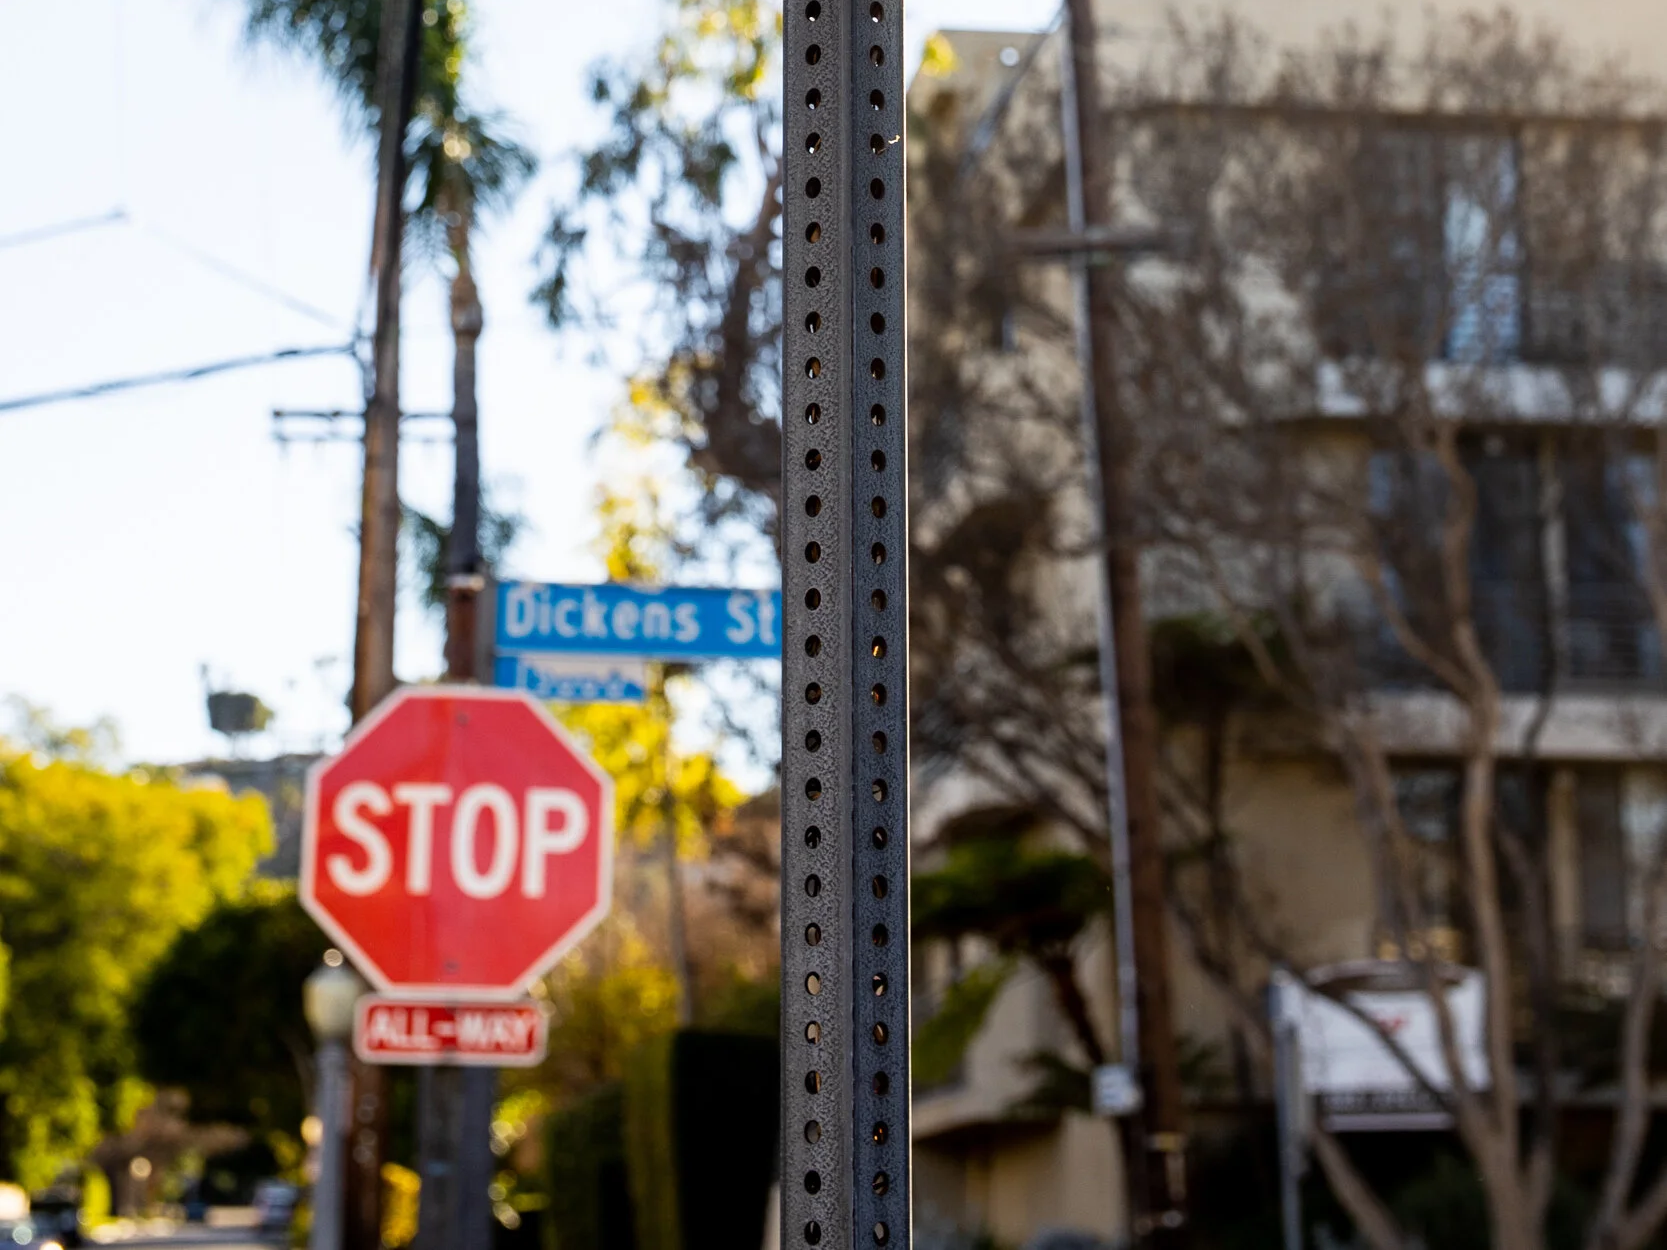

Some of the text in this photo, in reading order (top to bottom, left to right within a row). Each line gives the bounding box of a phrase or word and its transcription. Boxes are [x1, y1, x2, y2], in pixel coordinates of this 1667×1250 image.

[505, 587, 776, 645] Dickens St
[327, 782, 590, 899] STOP
[369, 1007, 537, 1051] ALL-WAY
